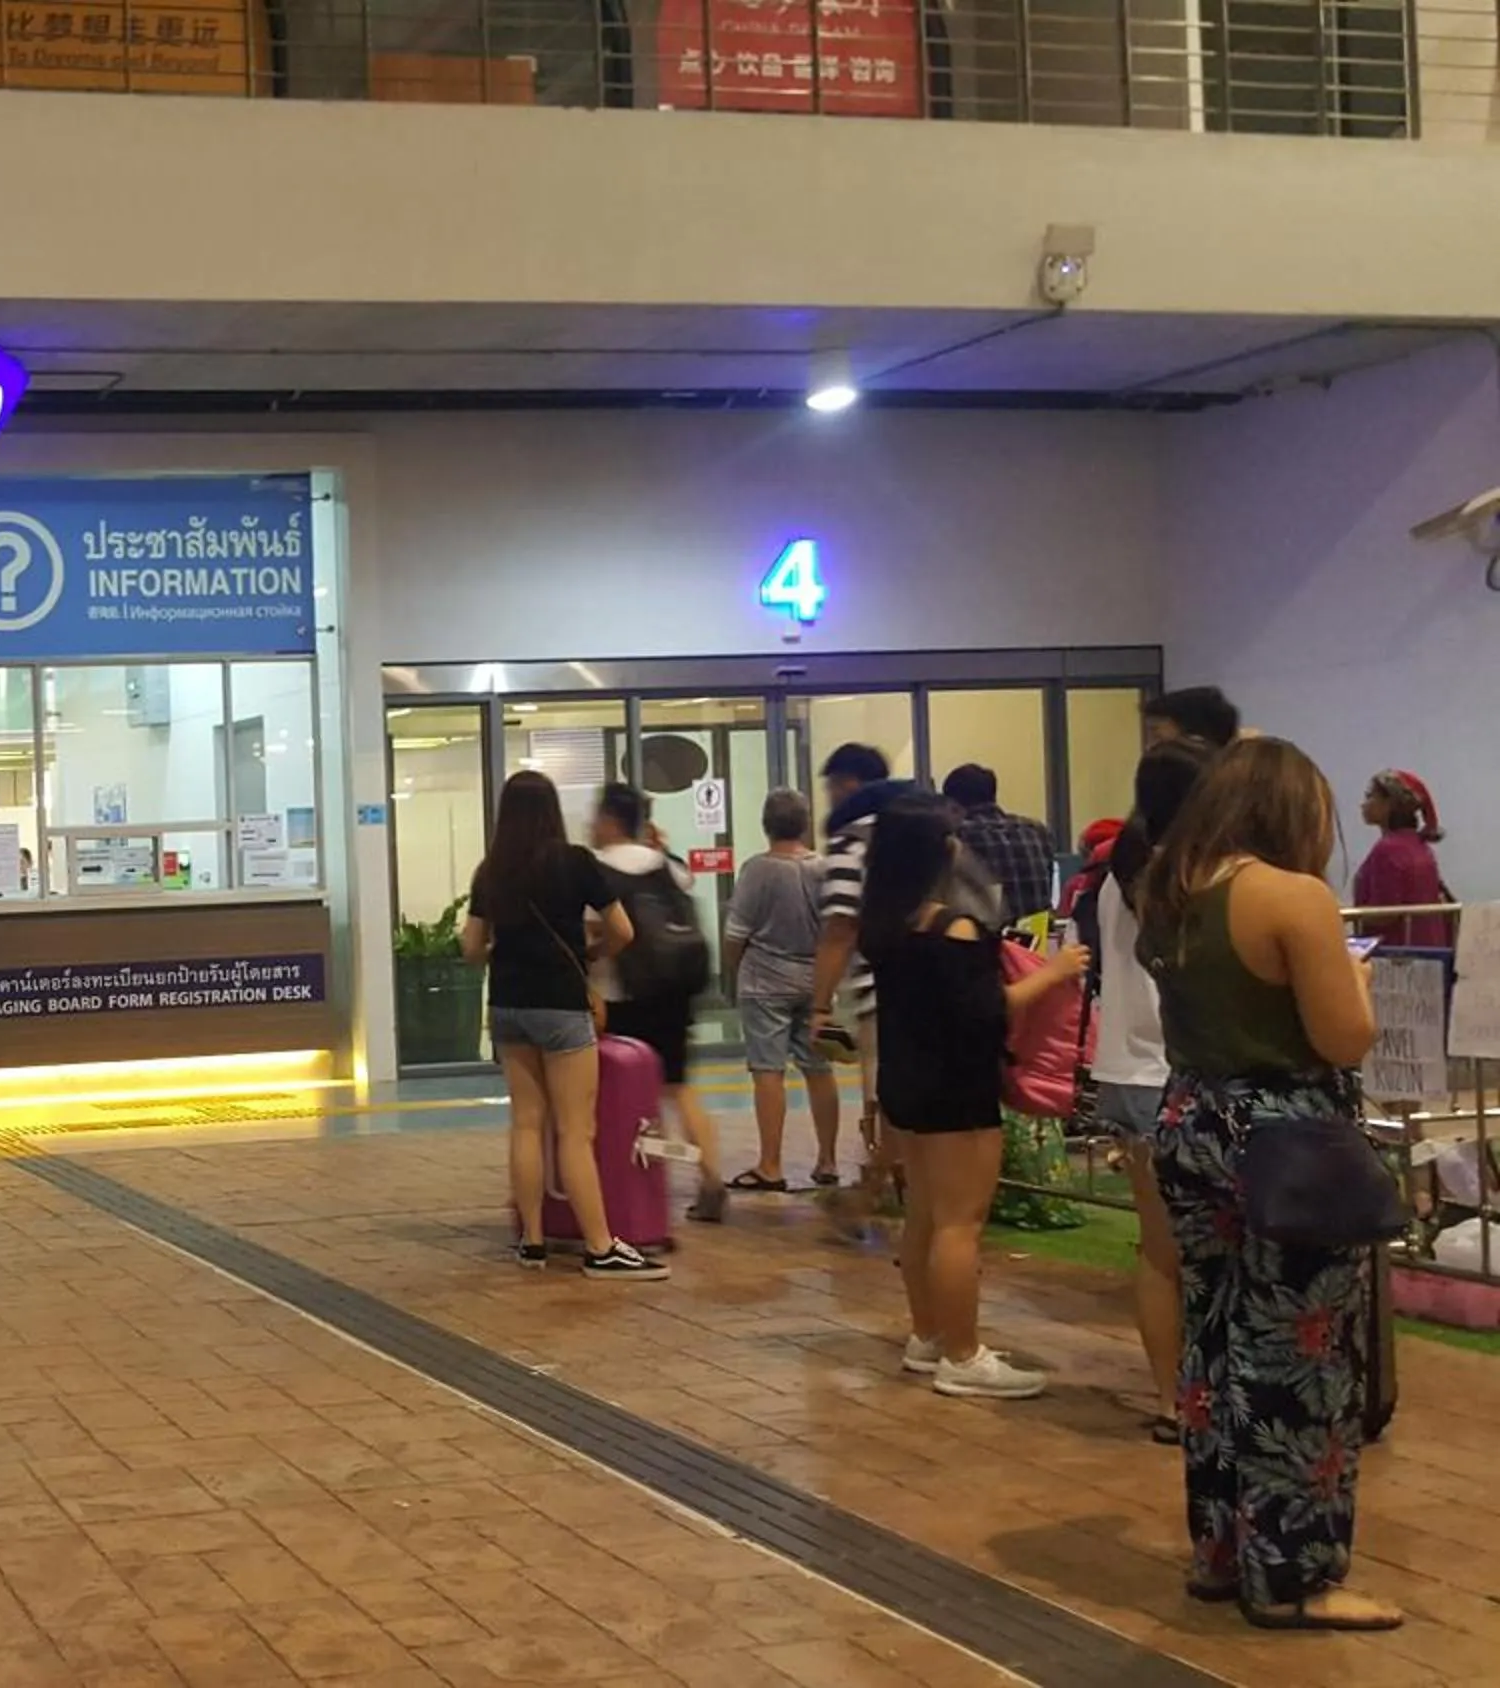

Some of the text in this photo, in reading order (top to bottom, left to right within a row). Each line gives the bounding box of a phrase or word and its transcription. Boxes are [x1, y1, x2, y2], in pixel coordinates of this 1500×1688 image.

[83, 511, 302, 560] ประชาสัมพันธ์
[88, 566, 302, 598] INFORMATION
[760, 537, 826, 622] 4
[129, 603, 253, 624] Информационная
[48, 996, 102, 1013] BOARD
[108, 993, 153, 1009] FORM
[159, 987, 267, 1007] REGISTRATION
[272, 984, 312, 1001] DESK
